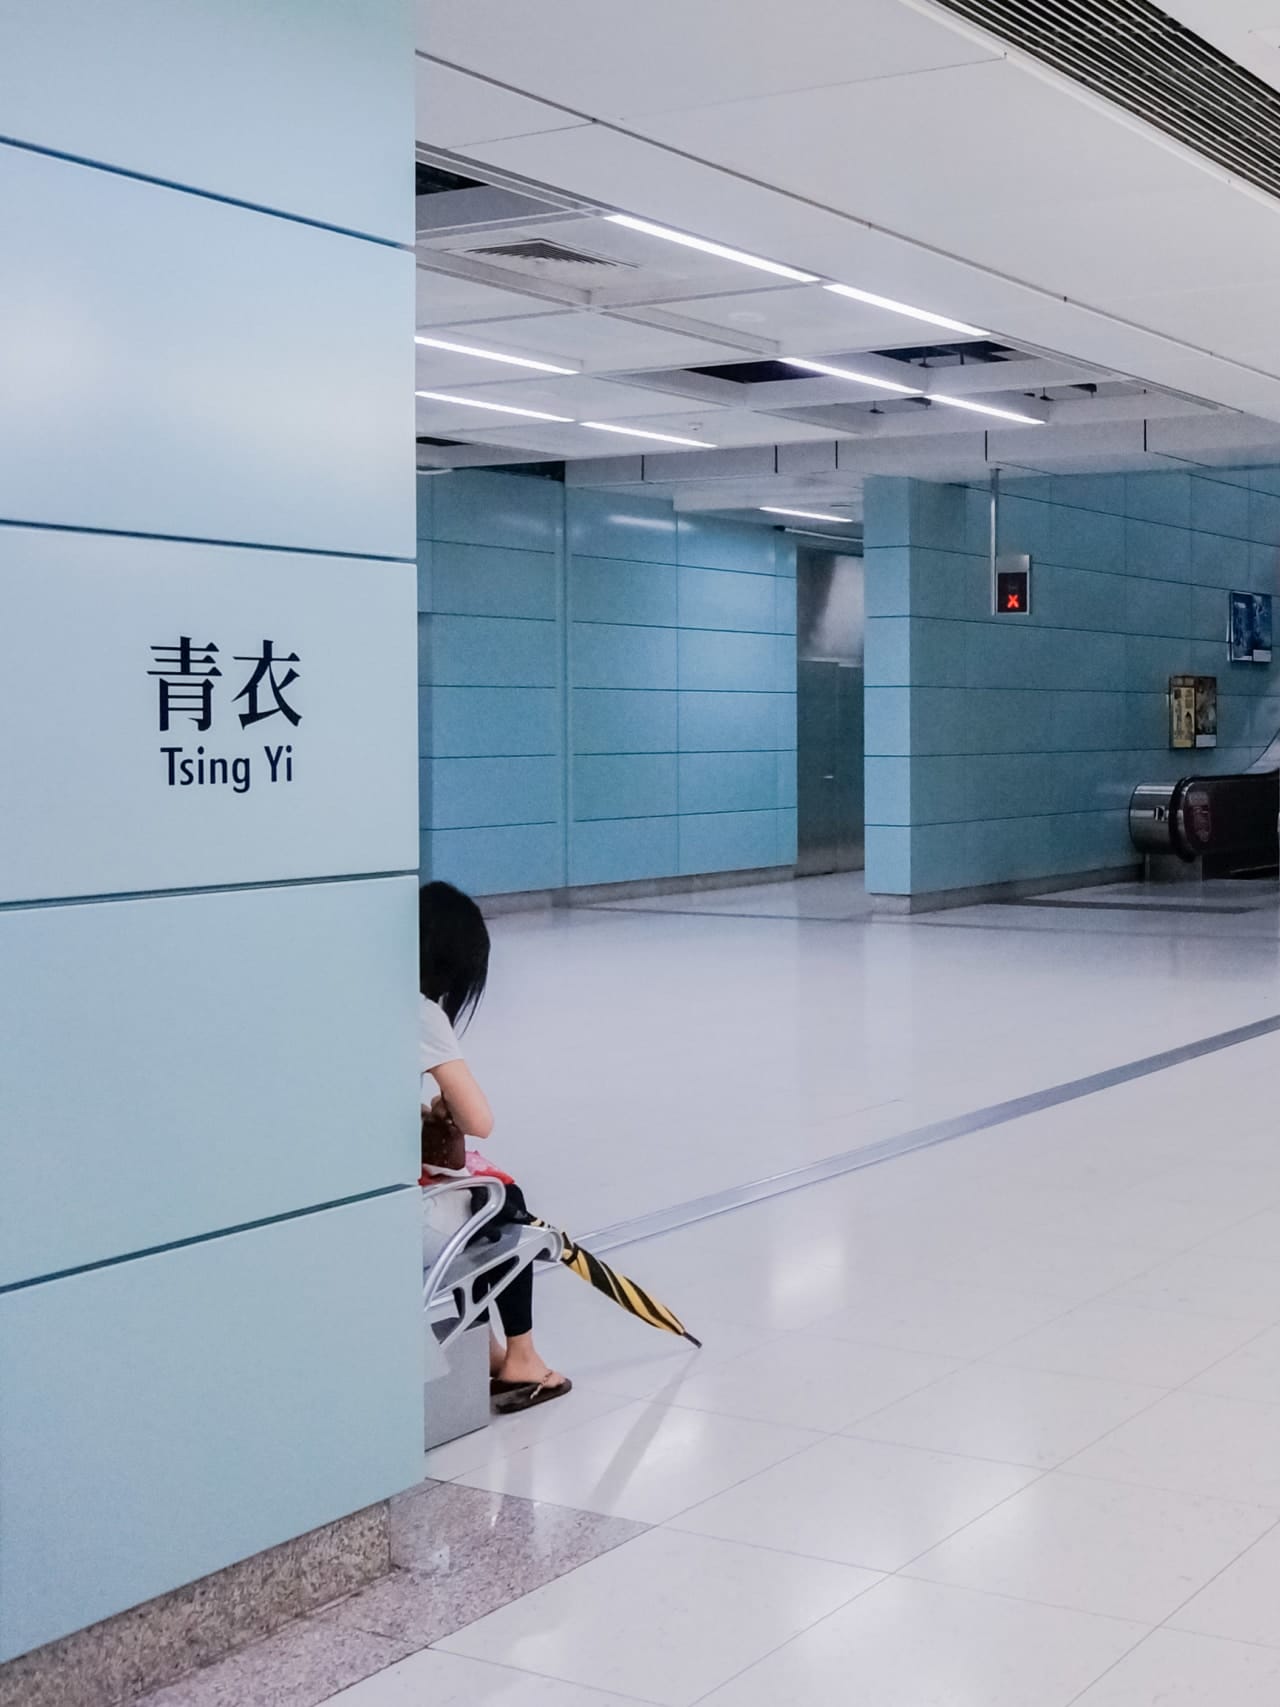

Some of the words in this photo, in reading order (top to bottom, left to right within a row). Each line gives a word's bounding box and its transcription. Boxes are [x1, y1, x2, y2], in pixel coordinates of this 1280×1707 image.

[147, 636, 302, 731] 青衣
[160, 745, 251, 793] Tsing
[264, 745, 293, 782] Yi
